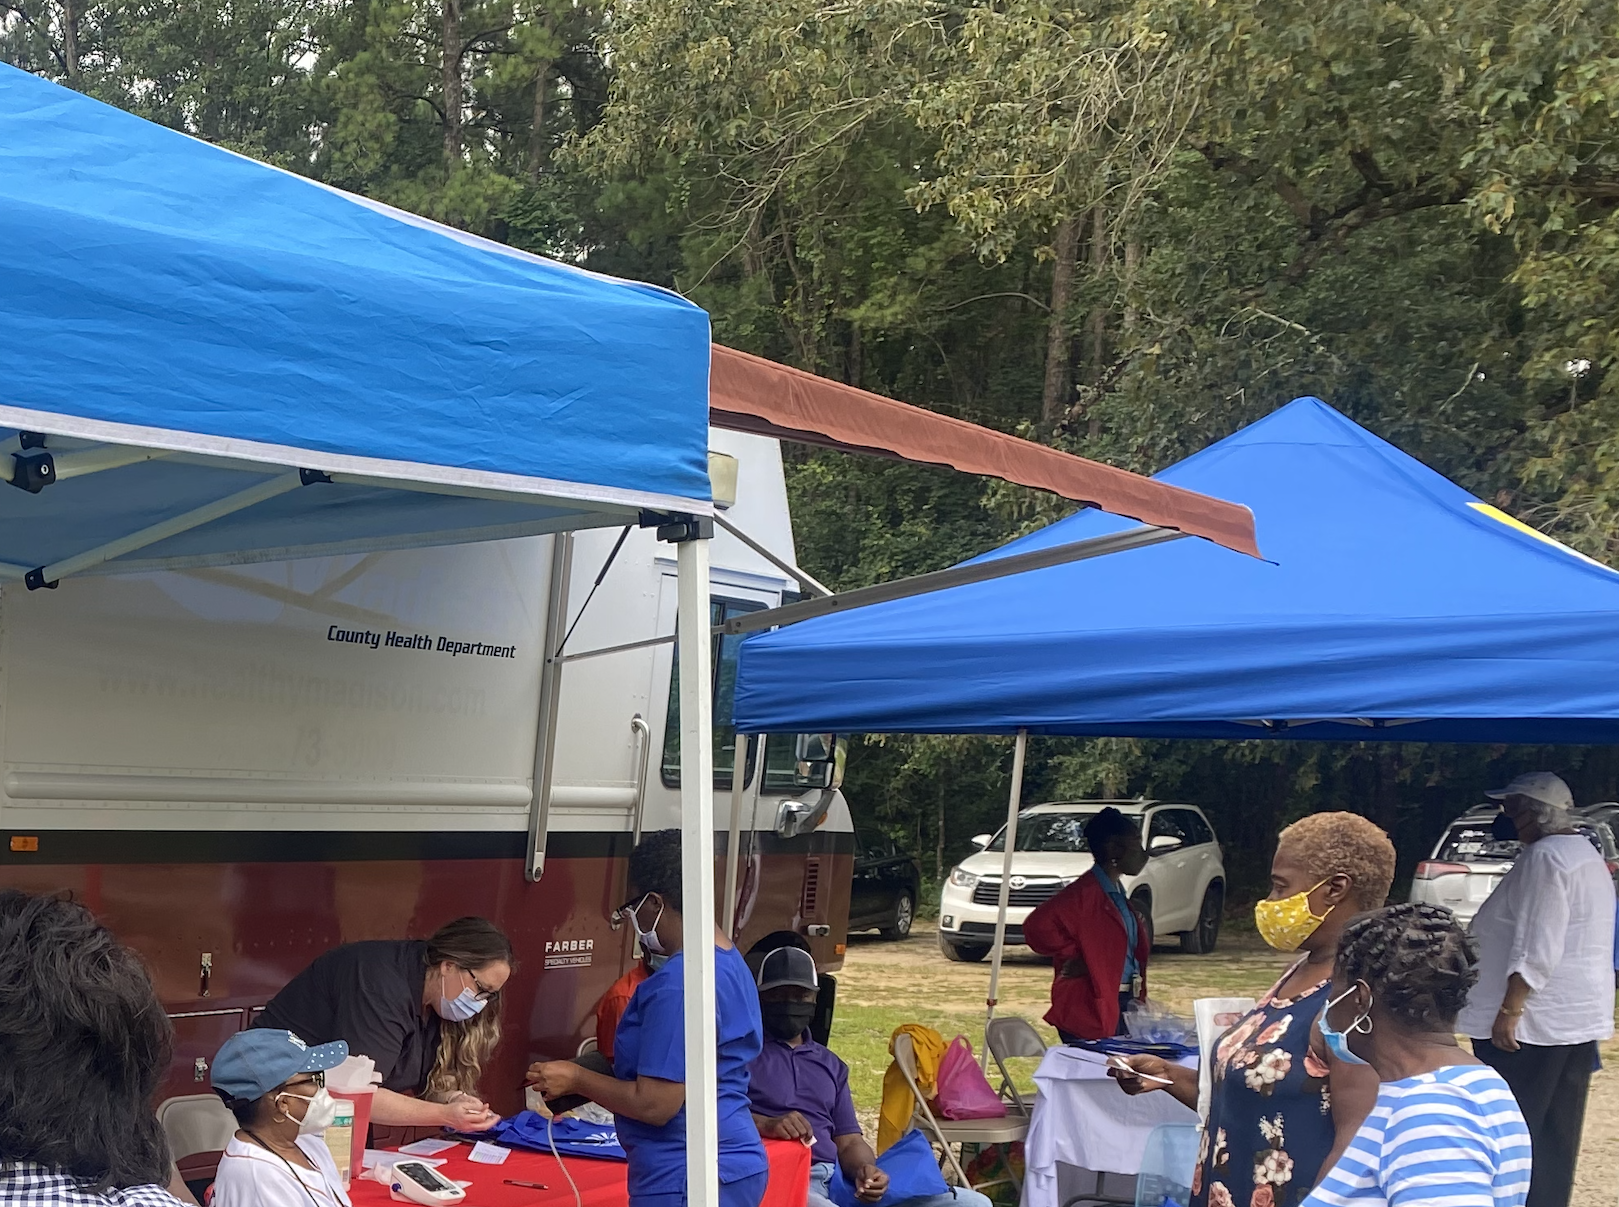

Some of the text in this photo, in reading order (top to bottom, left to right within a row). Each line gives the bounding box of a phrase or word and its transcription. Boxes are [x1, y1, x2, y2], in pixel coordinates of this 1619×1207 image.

[327, 625, 516, 659] County Health Department
[544, 939, 594, 953] FARBER
